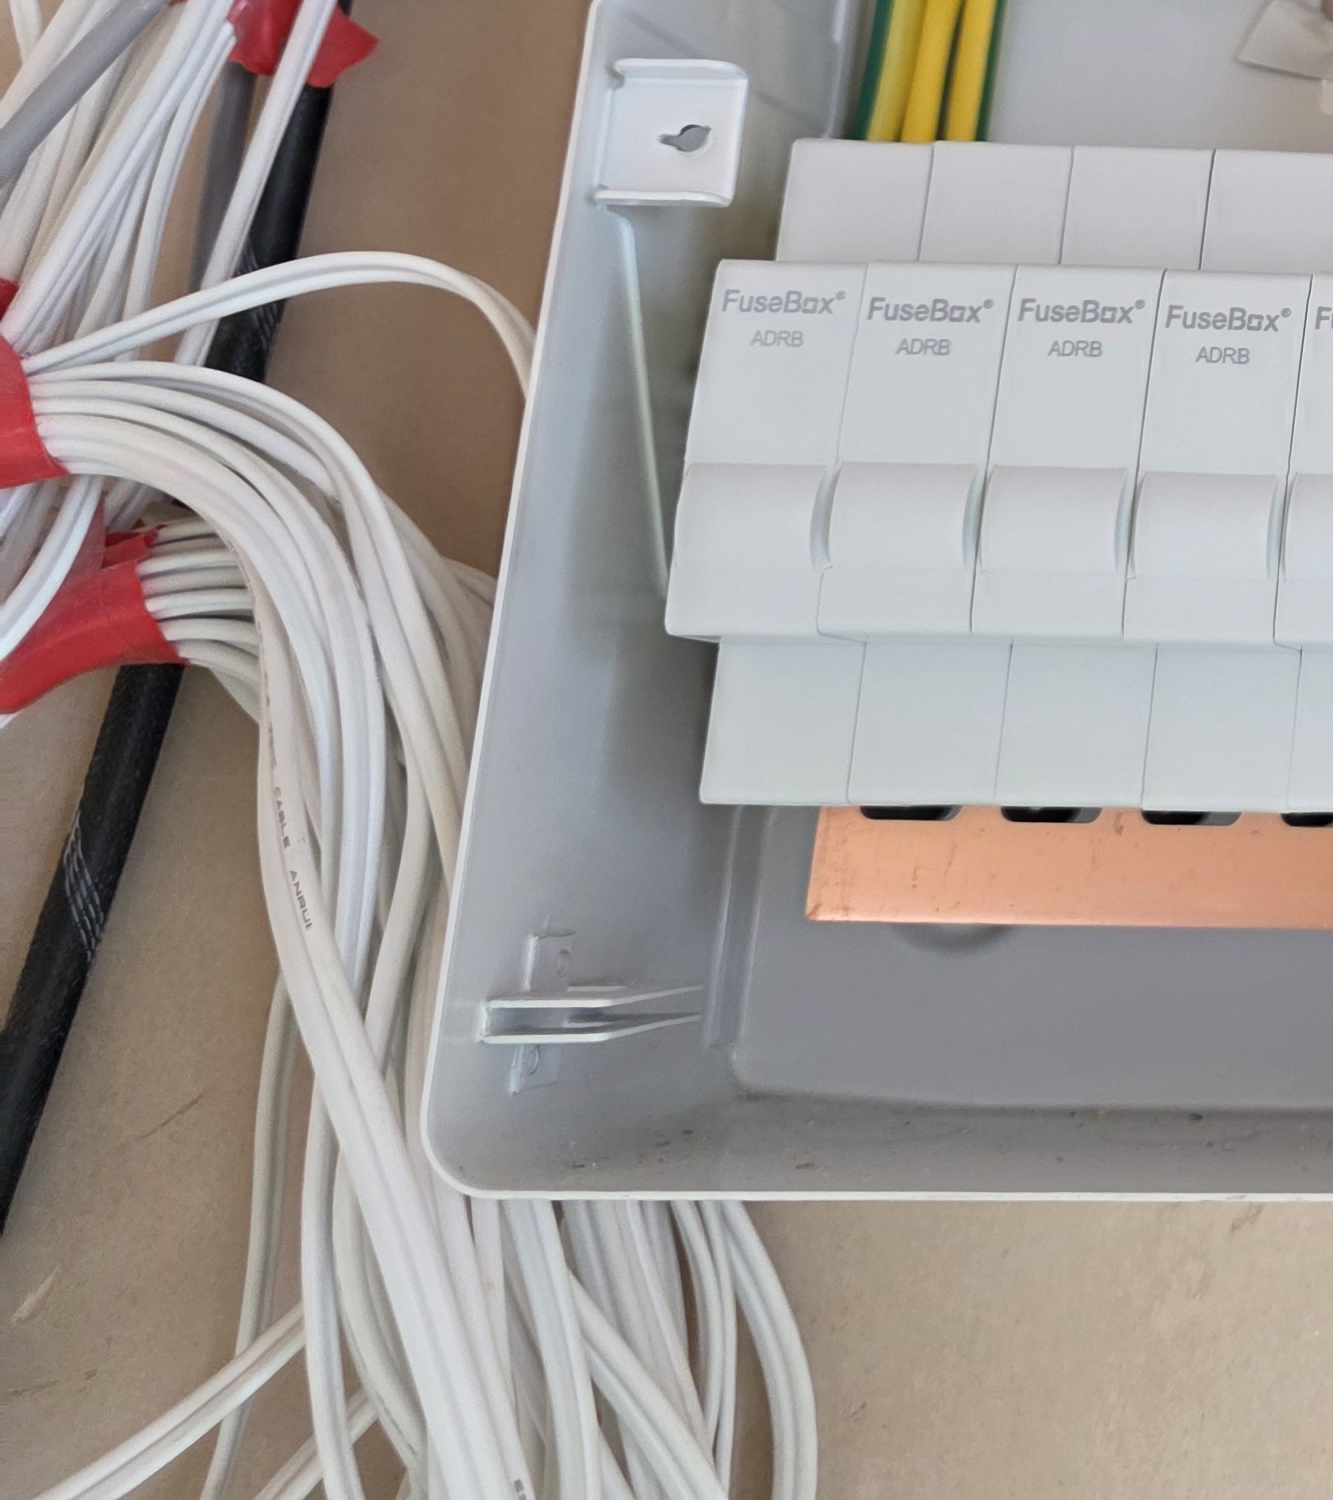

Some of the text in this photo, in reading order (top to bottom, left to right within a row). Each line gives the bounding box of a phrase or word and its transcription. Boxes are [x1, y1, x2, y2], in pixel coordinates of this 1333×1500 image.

[751, 330, 804, 347] ADRB
[897, 339, 951, 356] ADRB
[1049, 340, 1103, 357] ADRB
[1195, 347, 1250, 364] ADRB
